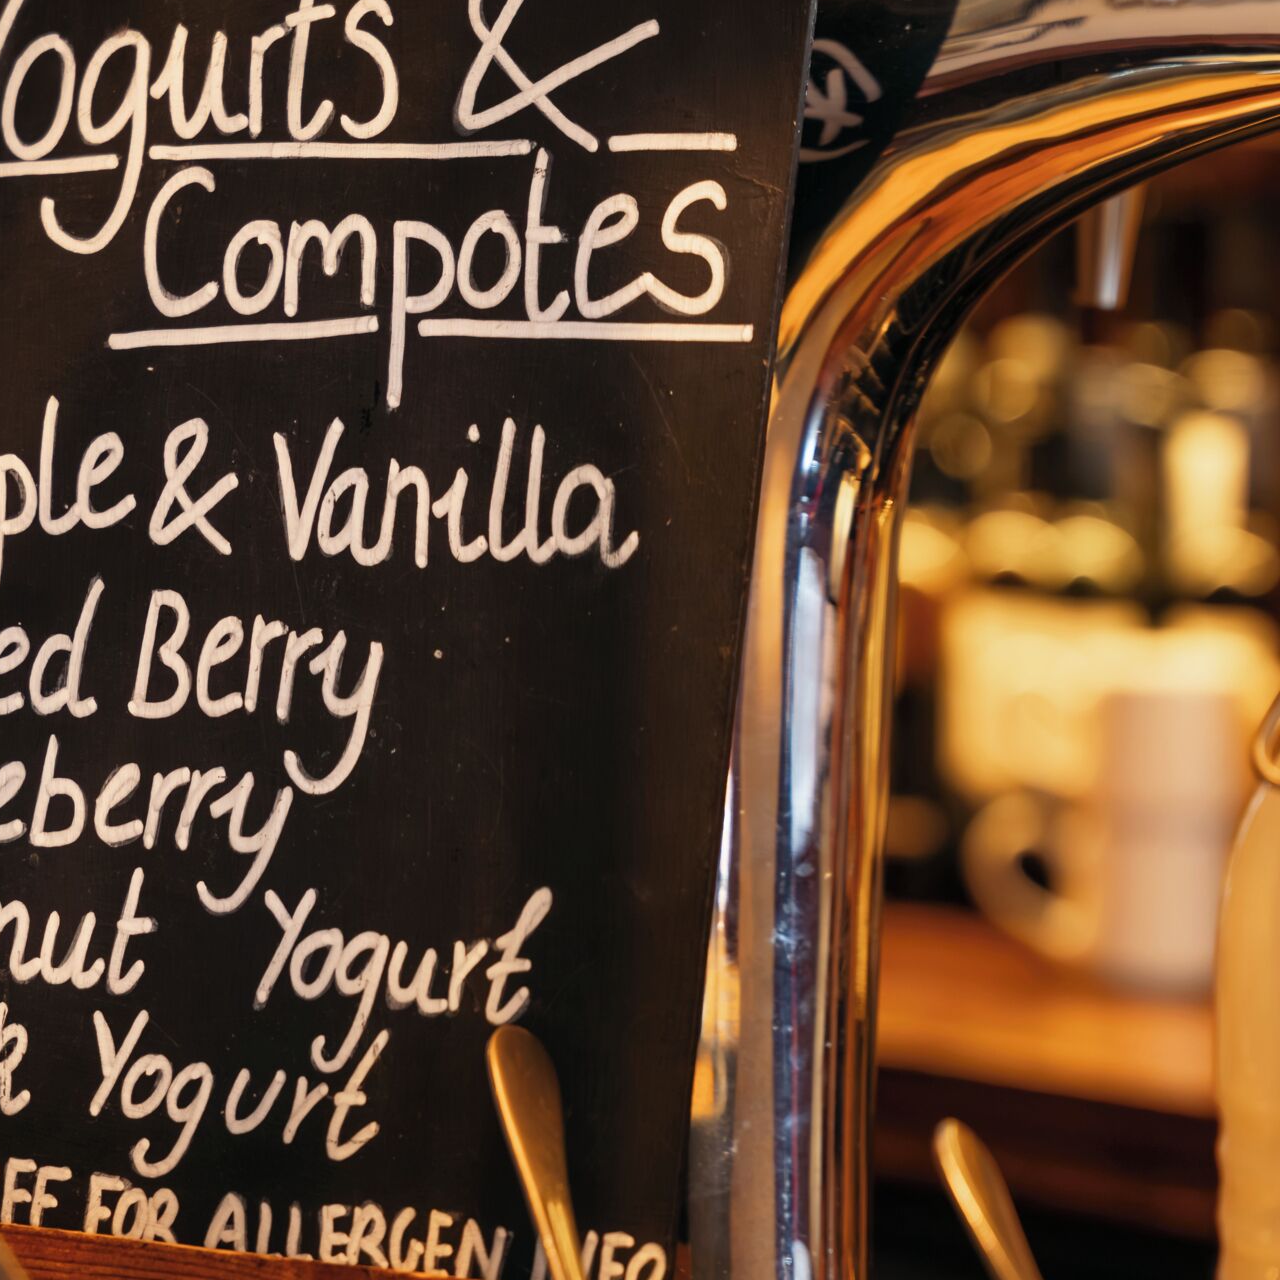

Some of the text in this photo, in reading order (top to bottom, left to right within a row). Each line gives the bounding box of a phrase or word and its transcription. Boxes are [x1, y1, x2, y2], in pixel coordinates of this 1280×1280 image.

[142, 148, 729, 412] Compotes
[147, 417, 240, 557] &
[272, 416, 641, 570] Vanilla
[126, 588, 385, 797] Berry
[255, 886, 554, 1074] Yogurt
[89, 1008, 391, 1180] Yogurt
[83, 1172, 180, 1244] FOR
